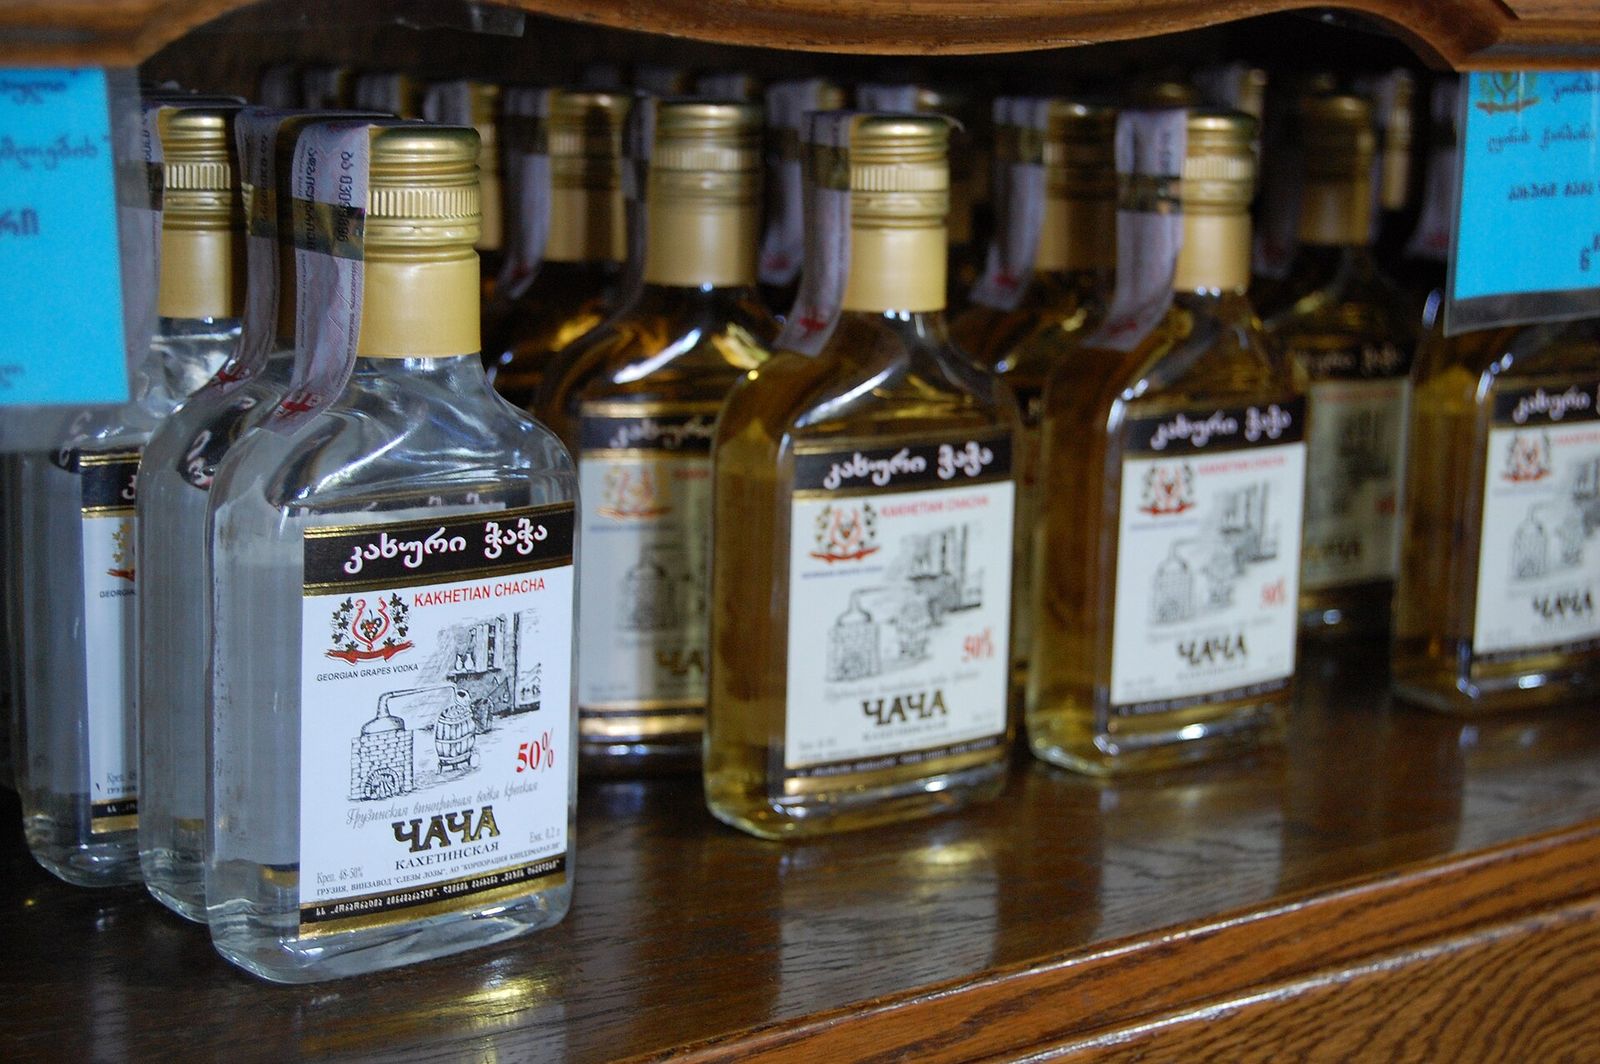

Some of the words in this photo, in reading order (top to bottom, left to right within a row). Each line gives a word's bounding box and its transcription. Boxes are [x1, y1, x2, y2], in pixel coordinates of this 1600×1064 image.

[1513, 387, 1591, 424] კახური
[1149, 410, 1239, 451] კახური
[1244, 404, 1292, 442] ჭაჭა
[823, 447, 928, 491] კახური
[937, 440, 994, 480] ჭაჭა
[343, 526, 467, 574] კახური
[484, 517, 549, 560] ჭაჭა
[413, 587, 491, 608] KAKHETIAN
[494, 577, 546, 597] CHACHA
[1176, 633, 1250, 667] ЧАЧА
[316, 671, 359, 682] GEORGIAN
[359, 667, 392, 678] GRAPES
[393, 663, 419, 674] VODKA
[861, 688, 949, 728] ЧАЧА
[515, 728, 556, 774] 50%
[346, 802, 409, 830] Грузинская
[392, 805, 500, 853] ЧАЧА
[395, 841, 499, 871] КАХЕТИНСКАЯ
